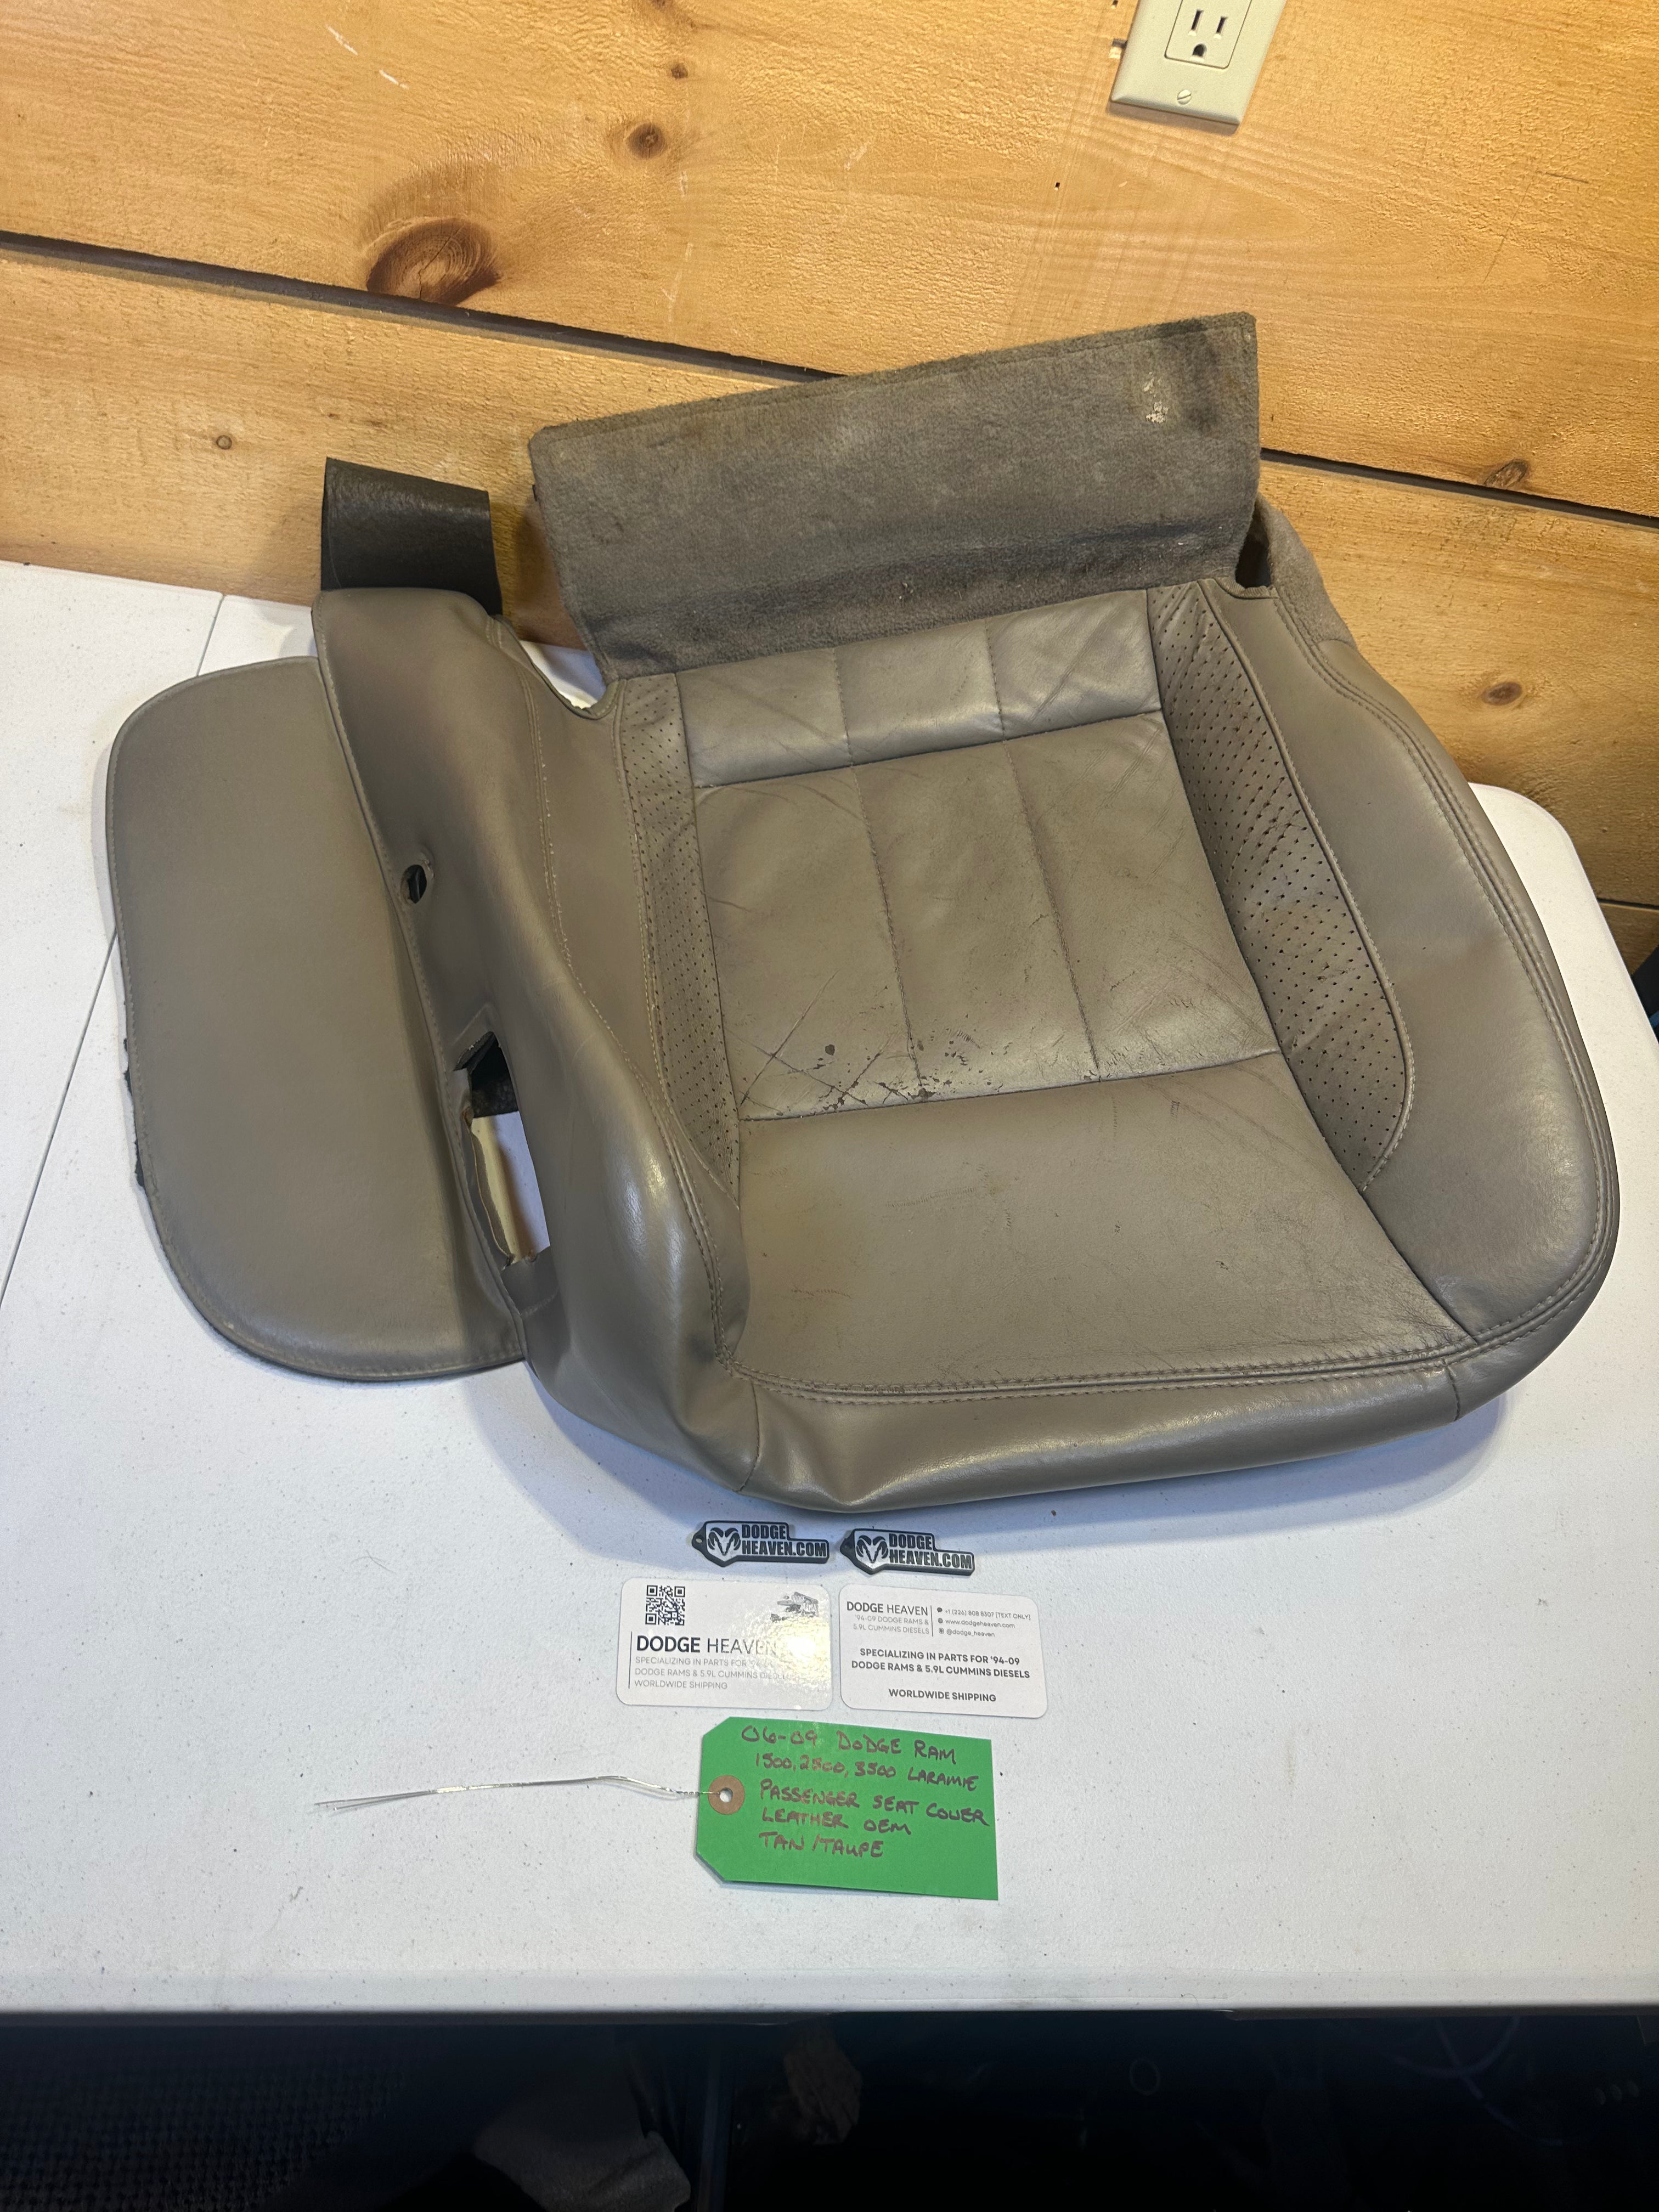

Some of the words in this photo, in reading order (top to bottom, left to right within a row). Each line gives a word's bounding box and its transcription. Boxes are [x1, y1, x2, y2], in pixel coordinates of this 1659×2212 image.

[742, 1524, 786, 1539] DODGE
[742, 1540, 827, 1557] HEAVEN.COM
[889, 1533, 933, 1550] DODGE
[889, 1549, 972, 1569] HEAVEN.COM
[847, 1601, 884, 1613] DODGE
[887, 1604, 928, 1616] HEAVEN
[877, 1616, 902, 1624] DODGE
[945, 1618, 1015, 1629] www.dodgeheaven.com
[853, 1623, 867, 1631] 5.9L
[868, 1624, 901, 1633] CUMMINS
[902, 1626, 930, 1634] DIESELS
[946, 1628, 995, 1638] @dodge_heaven
[636, 1635, 701, 1654] DODGE
[707, 1637, 777, 1656] HEAVEN
[635, 1656, 691, 1666] SPECIALIZING
[860, 1647, 924, 1660] SPECIALIZING
[926, 1652, 936, 1660] IN
[938, 1652, 968, 1662] PARTS
[970, 1654, 989, 1663] FOR
[635, 1667, 665, 1676] DODGE
[700, 1669, 716, 1678] 5.9L
[718, 1670, 758, 1679] CUMMINS
[851, 1660, 885, 1670] DODGE
[888, 1662, 915, 1672] RAMS
[916, 1664, 923, 1672] &
[925, 1664, 944, 1673] 5.9L
[946, 1666, 992, 1677] CUMMINS
[994, 1669, 1030, 1679] DIESELS
[635, 1679, 687, 1689] WORLDWIDE
[689, 1680, 728, 1690] SHIPPING
[888, 1688, 950, 1700] WORLDWIDE
[952, 1691, 997, 1702] SHIPPING
[741, 1725, 818, 1750] 06-09
[836, 1730, 902, 1754] DODGE
[914, 1739, 956, 1765] RAM
[907, 1767, 979, 1791] LARAMIE
[760, 1778, 860, 1808] PASSENGER
[872, 1794, 920, 1815] SEAT
[762, 1806, 849, 1829] LEATHER
[864, 1818, 912, 1835] OEM
[758, 1831, 805, 1850] TAN
